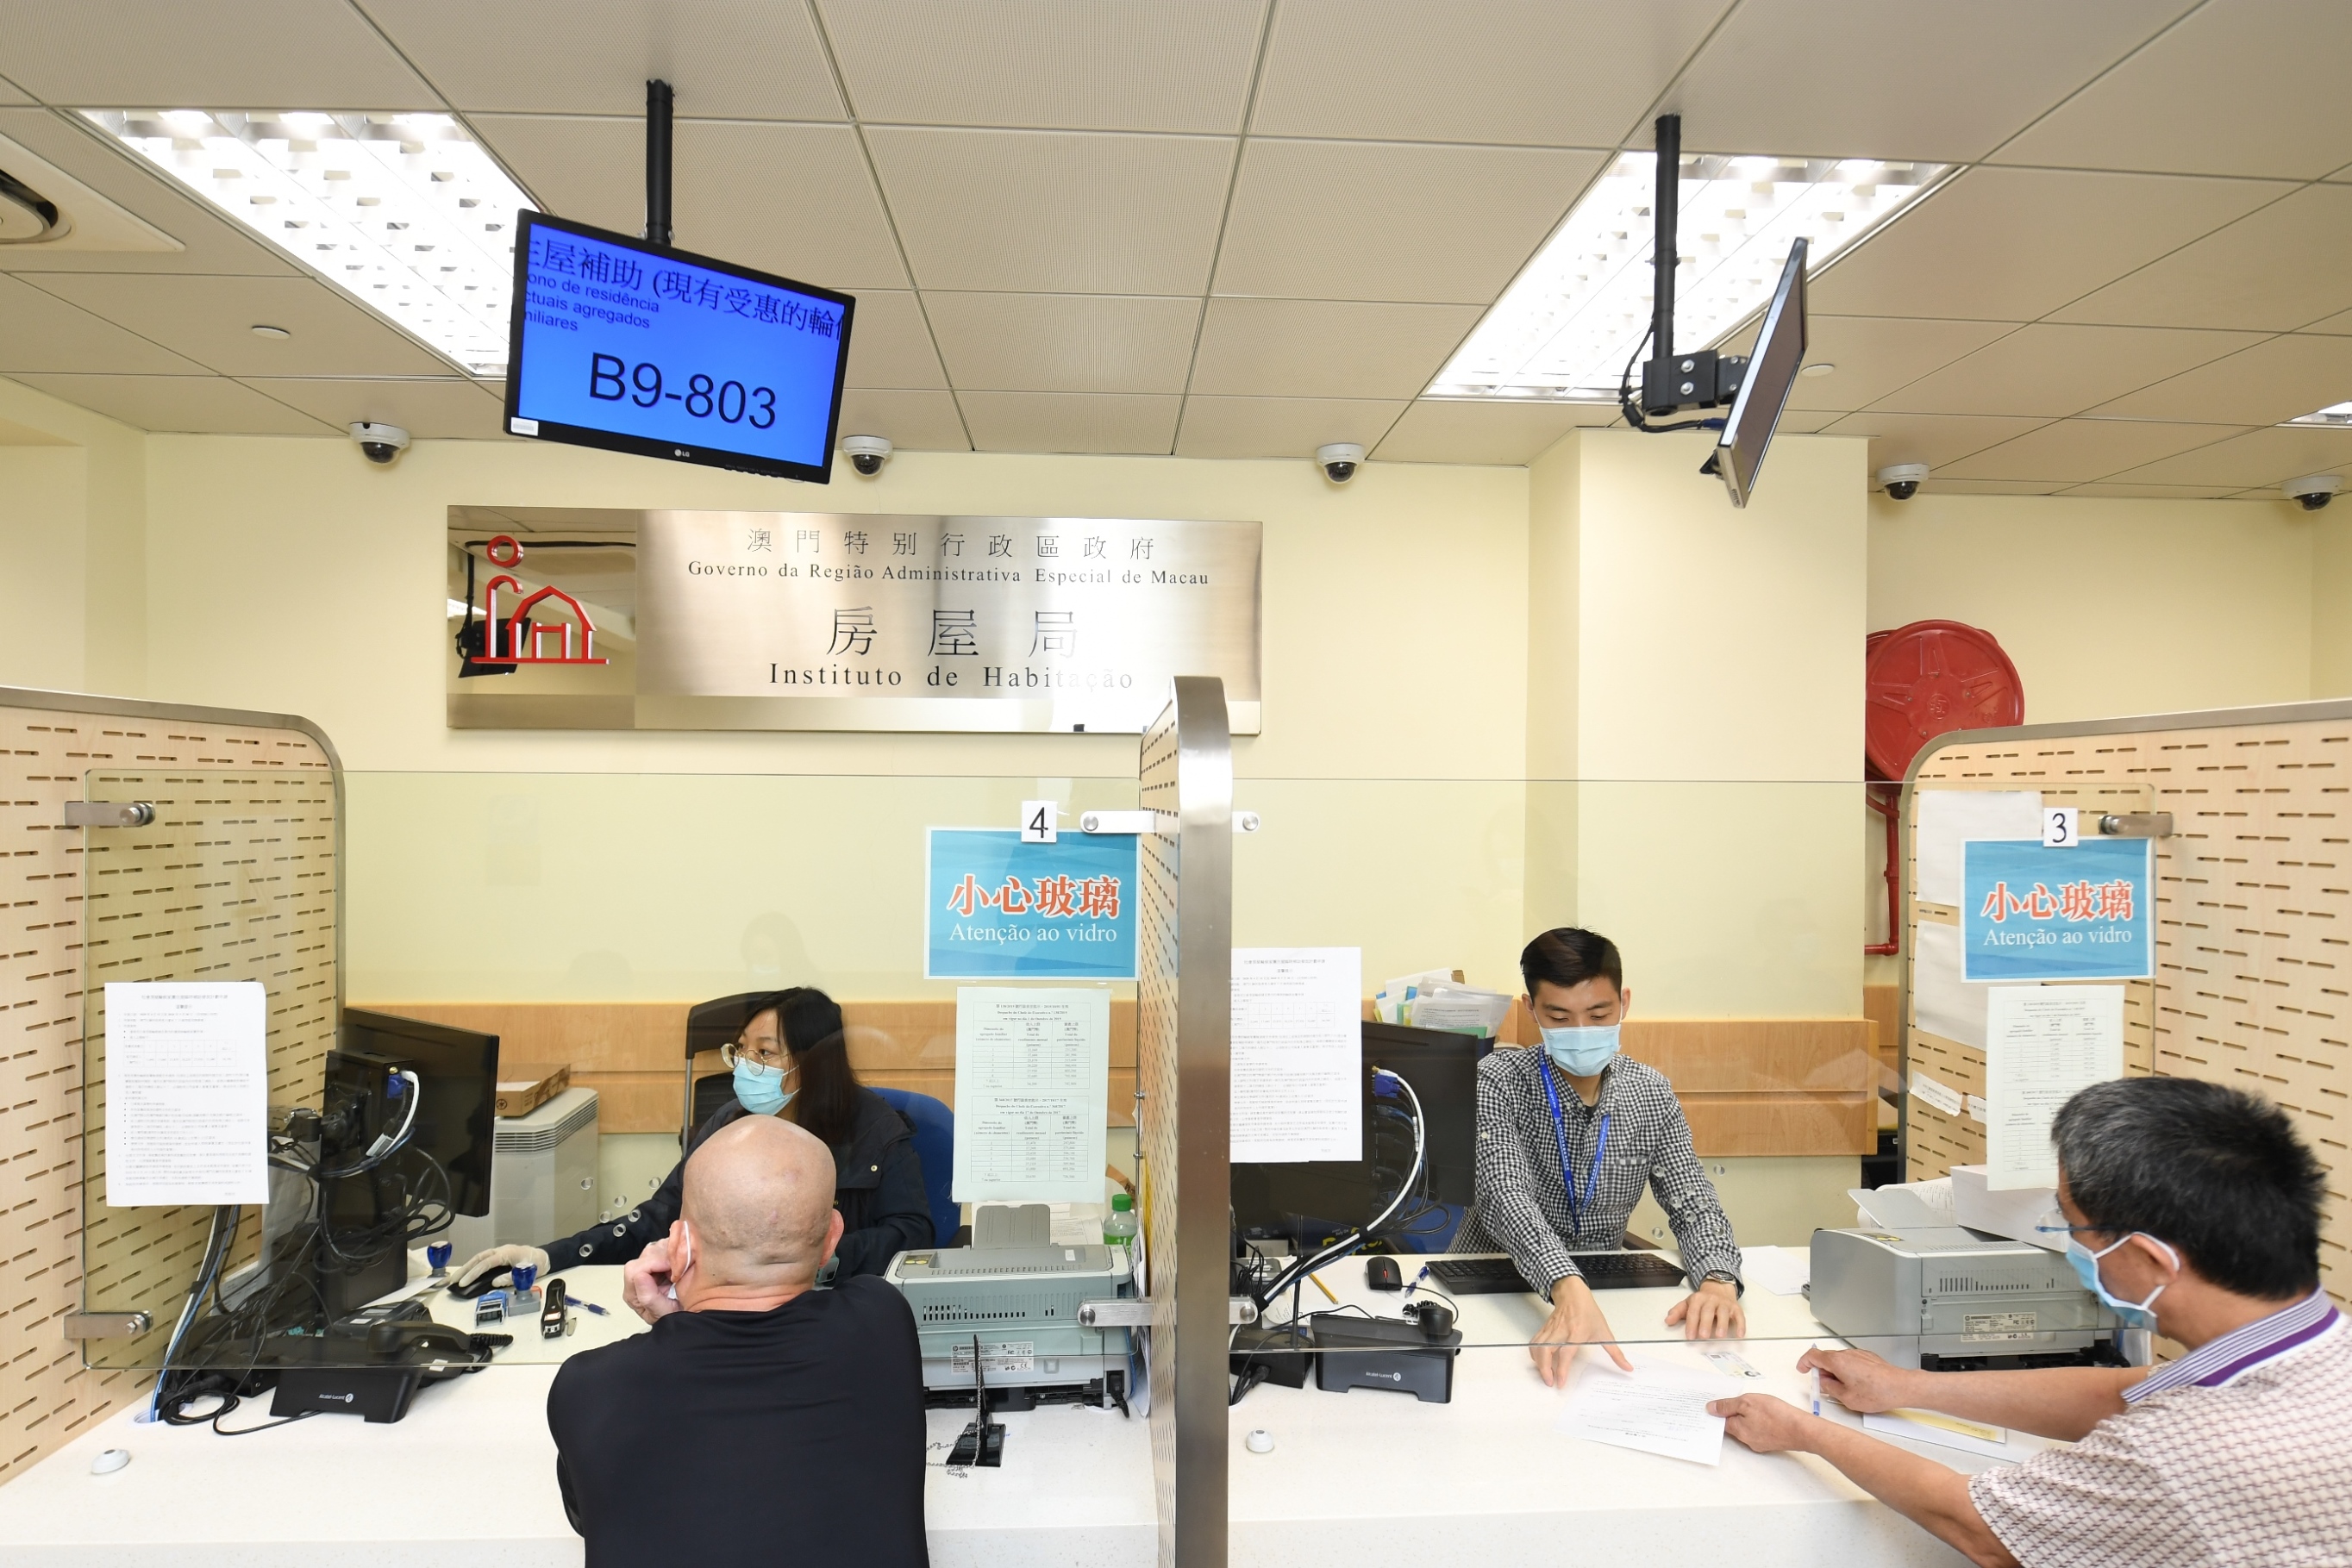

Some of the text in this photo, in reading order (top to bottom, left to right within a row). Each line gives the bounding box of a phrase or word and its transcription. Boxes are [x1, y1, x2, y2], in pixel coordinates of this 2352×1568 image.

[561, 278, 580, 295] de
[585, 285, 660, 313] residência
[572, 302, 650, 328] agregados
[589, 352, 777, 429] B9-803
[688, 561, 1208, 586] Governo da Região Administrativa Especial de Macau
[826, 605, 1078, 659] 房屋局
[769, 663, 1132, 693] Instituto de Habitação
[1029, 806, 1049, 839] 4
[2052, 813, 2067, 843] 3
[947, 873, 1122, 919] 小心玻璃
[1980, 879, 2134, 923] 小心玻璃
[948, 922, 1117, 946] Atenção ao vidro
[1983, 926, 2132, 949] Atenção ao vidro
